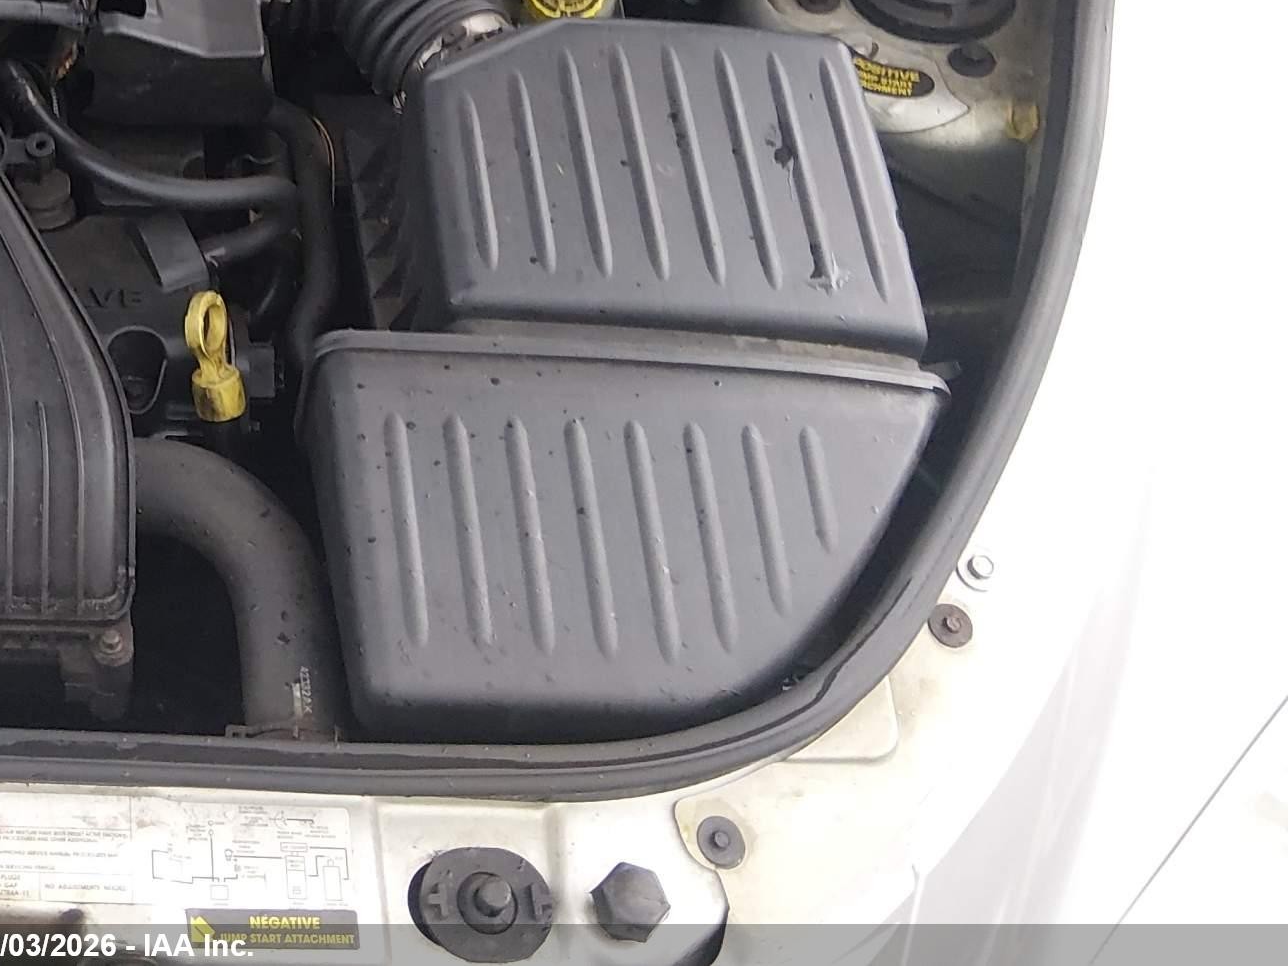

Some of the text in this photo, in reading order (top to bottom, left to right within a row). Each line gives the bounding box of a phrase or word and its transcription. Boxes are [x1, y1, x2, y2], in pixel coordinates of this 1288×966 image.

[249, 915, 321, 931] NEGATIVE
[250, 933, 281, 945] START
[283, 933, 355, 945] ATTACHMENT
